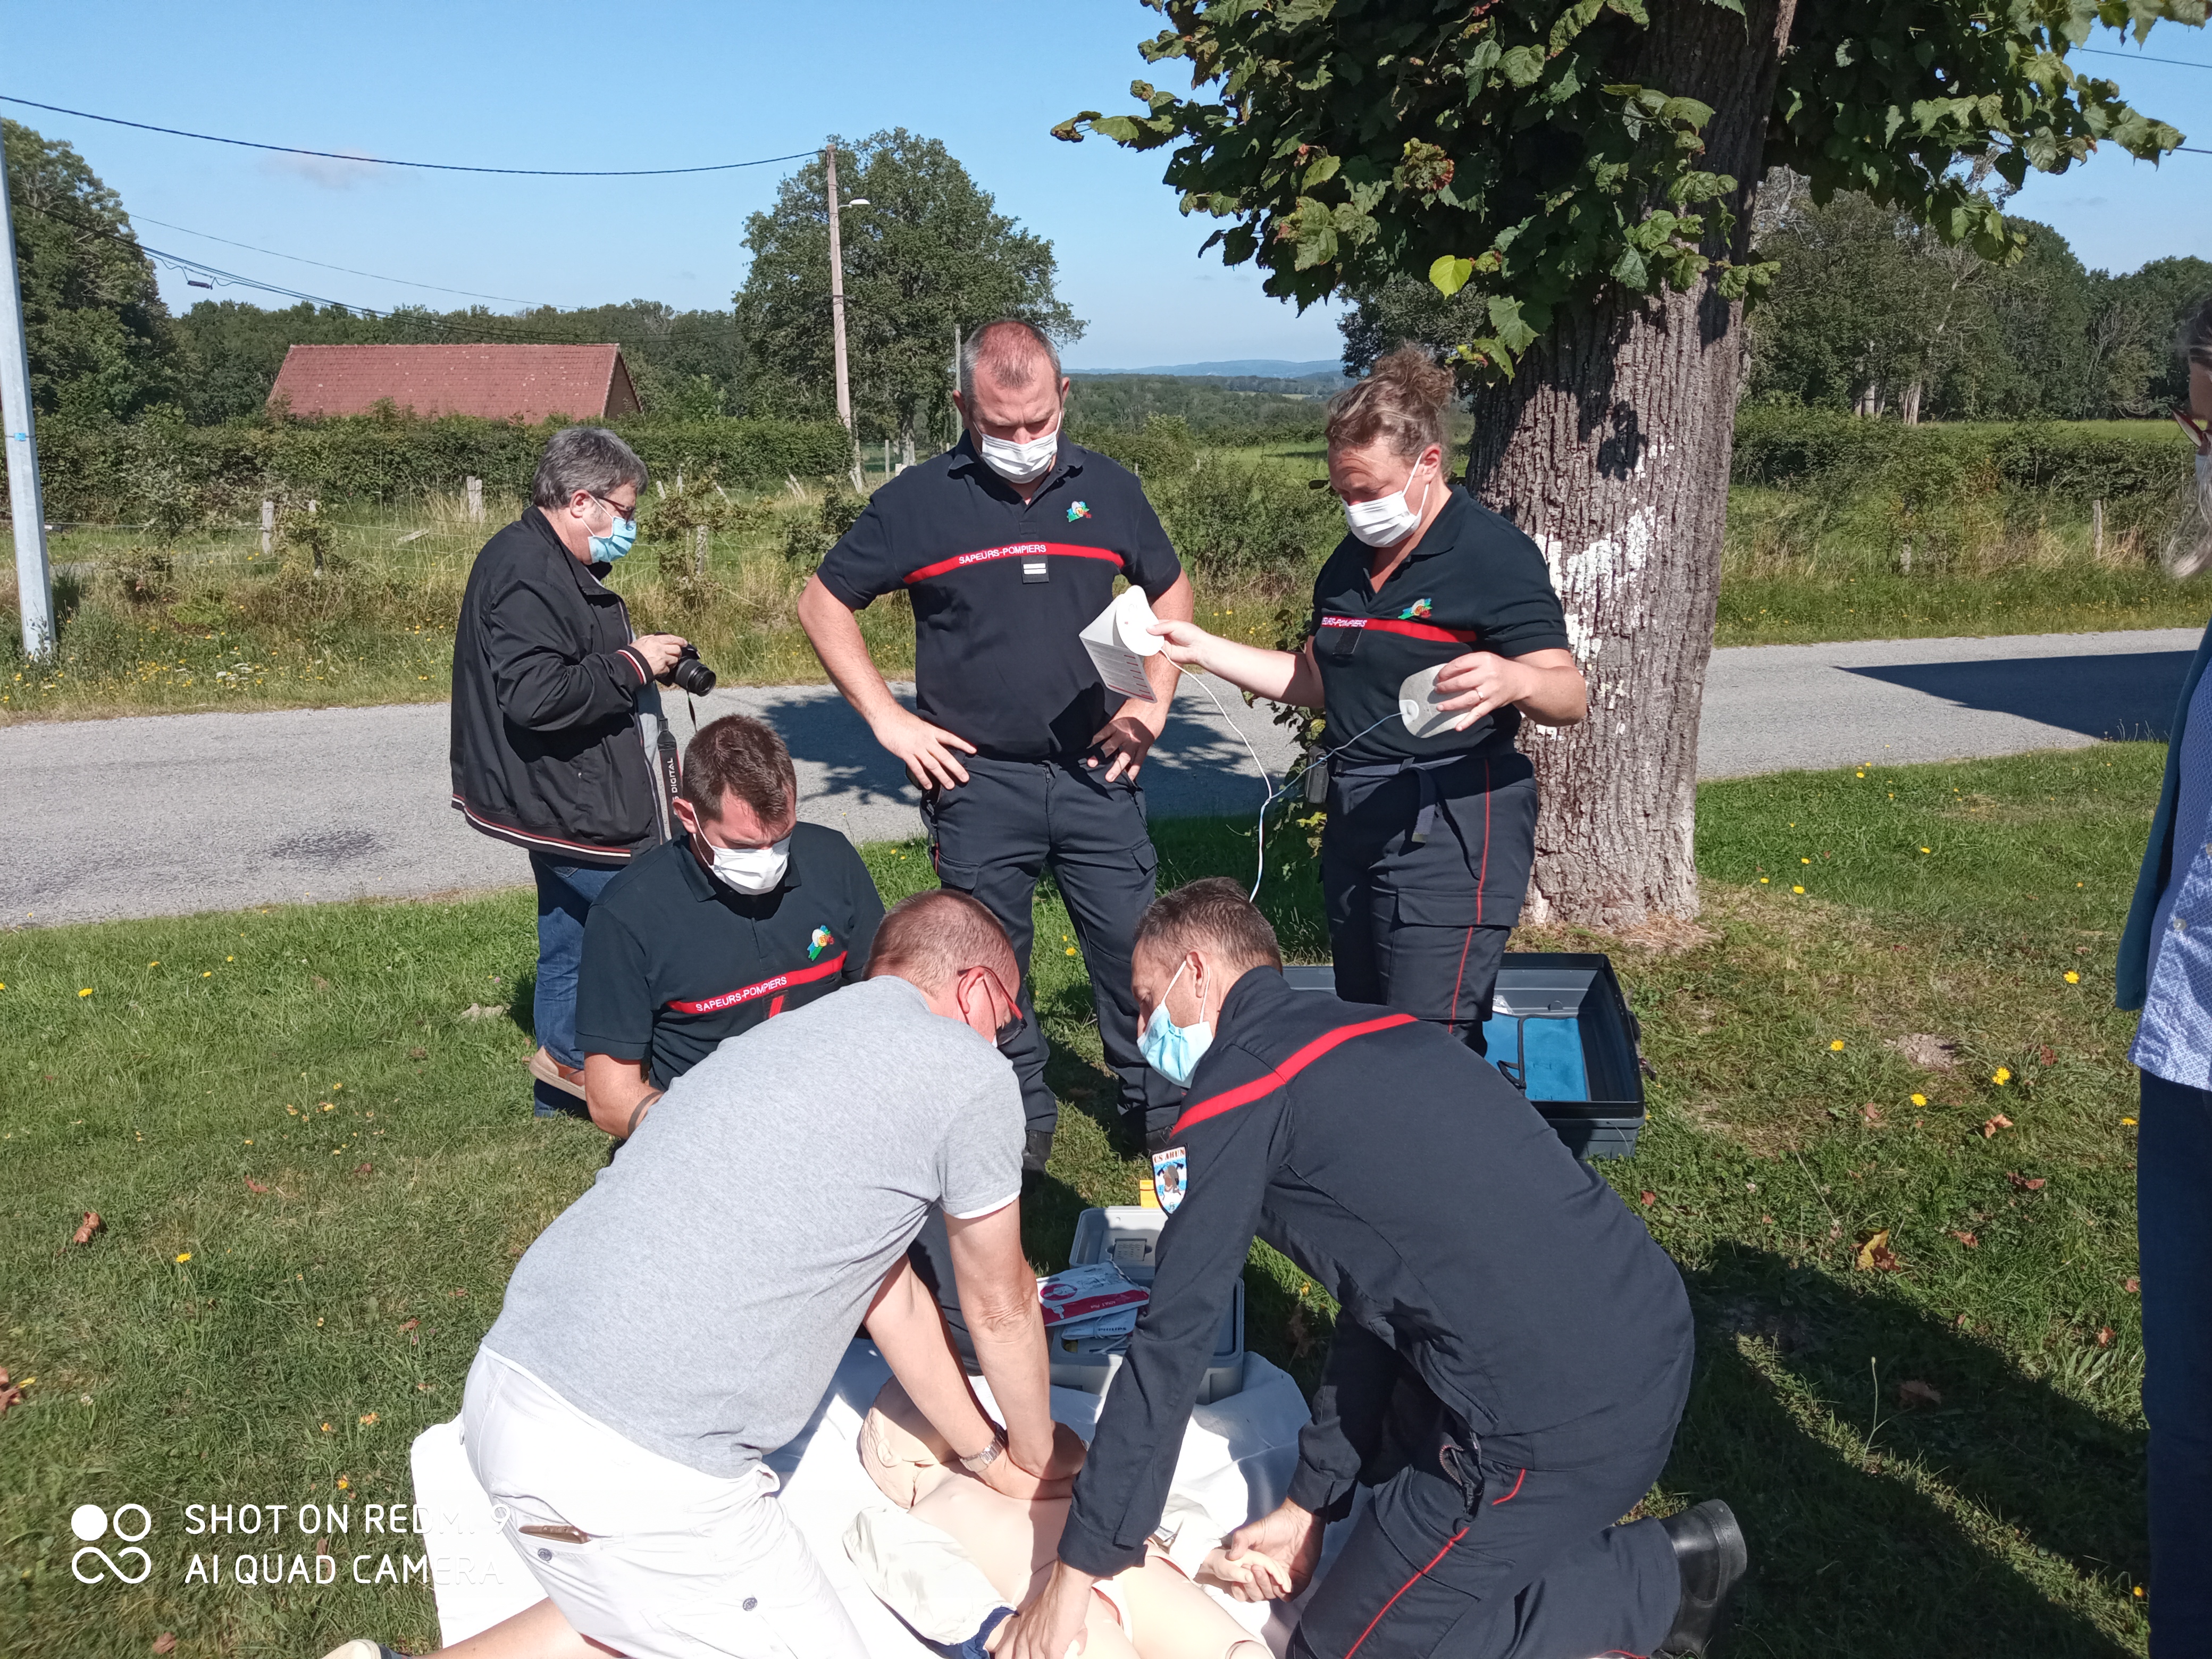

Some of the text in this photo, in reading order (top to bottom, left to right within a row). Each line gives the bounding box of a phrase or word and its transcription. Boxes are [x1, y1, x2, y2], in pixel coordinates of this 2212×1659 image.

[959, 544, 1047, 564] SAPEURS-POMPIERS
[667, 757, 678, 794] DIGITAL
[696, 976, 787, 1012] SAPEURS-POMPIERS
[1154, 1149, 1185, 1163] CS AHUN
